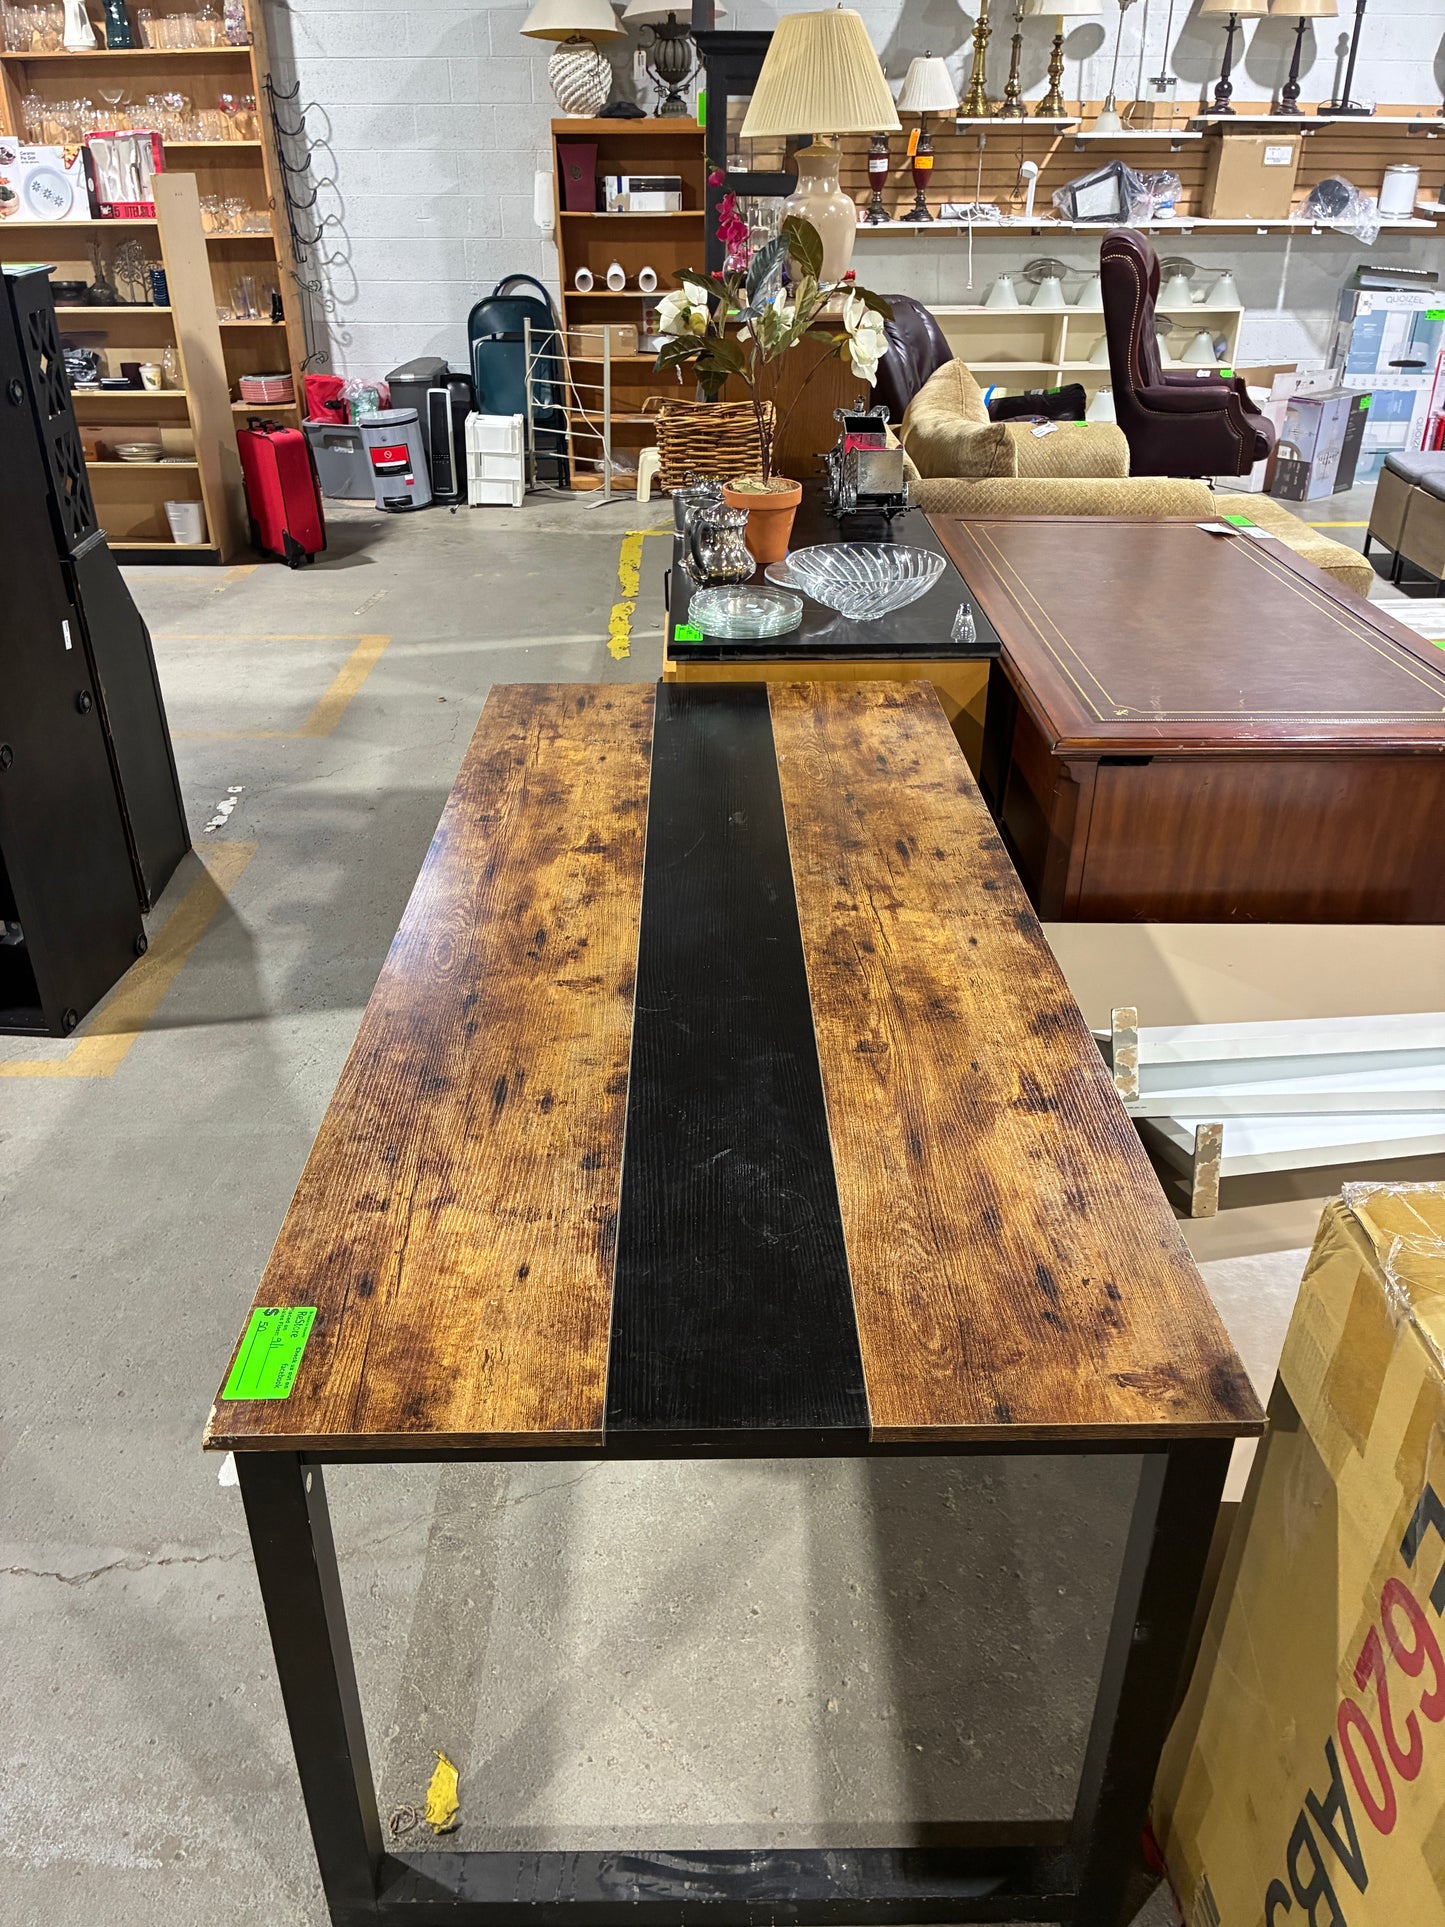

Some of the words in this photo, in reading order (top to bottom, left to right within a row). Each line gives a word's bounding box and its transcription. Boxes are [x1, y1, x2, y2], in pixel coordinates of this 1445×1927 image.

[1386, 294, 1424, 304] QUOIZEL
[263, 1308, 279, 1316] $
[257, 1321, 269, 1331] 50
[290, 1311, 307, 1338] ReStore
